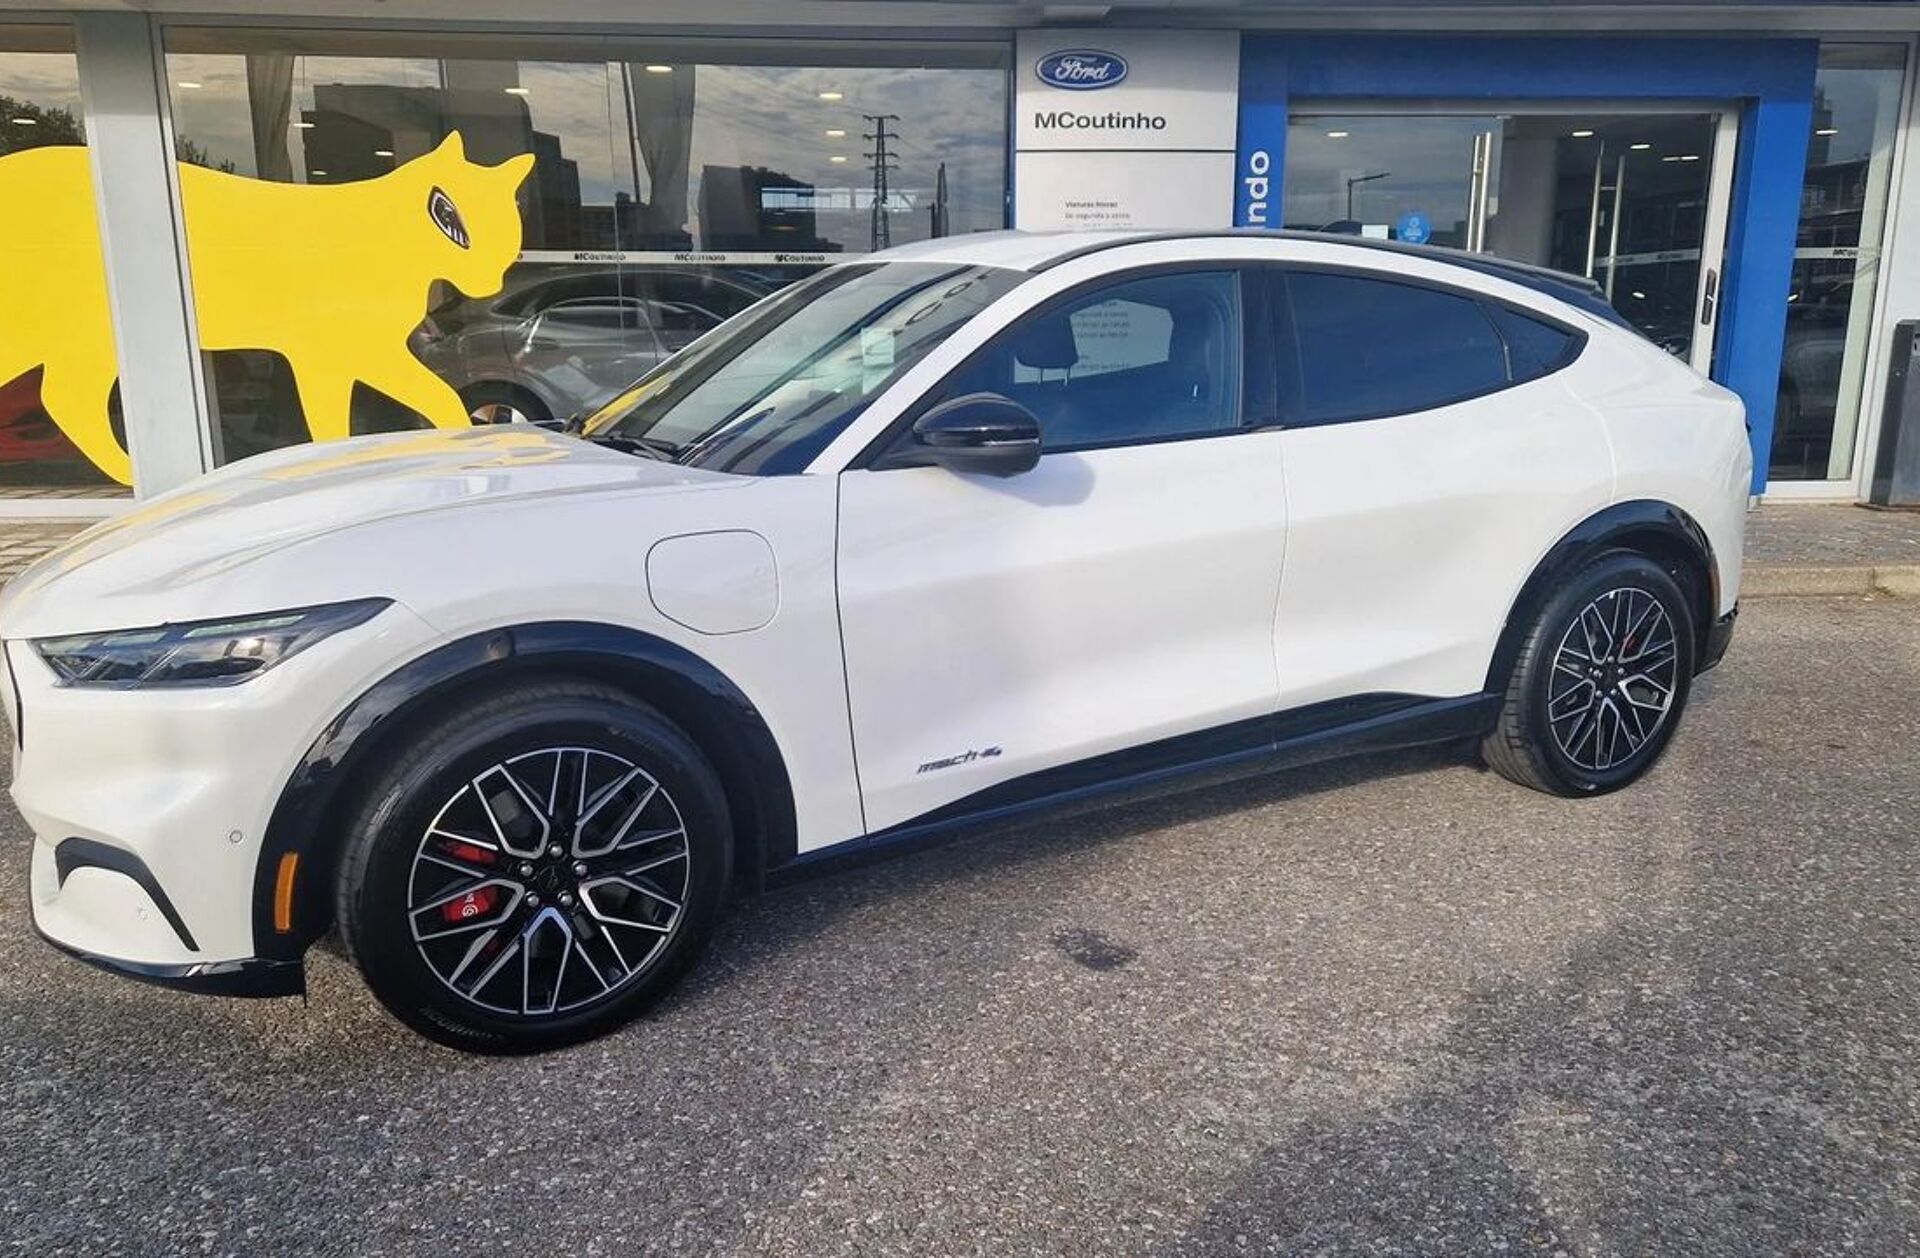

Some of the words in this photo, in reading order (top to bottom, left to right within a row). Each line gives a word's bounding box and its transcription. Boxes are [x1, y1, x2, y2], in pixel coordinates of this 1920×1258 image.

[1054, 56, 1111, 80] Ford
[1034, 111, 1167, 130] MCoutinho
[1245, 150, 1270, 229] ndo
